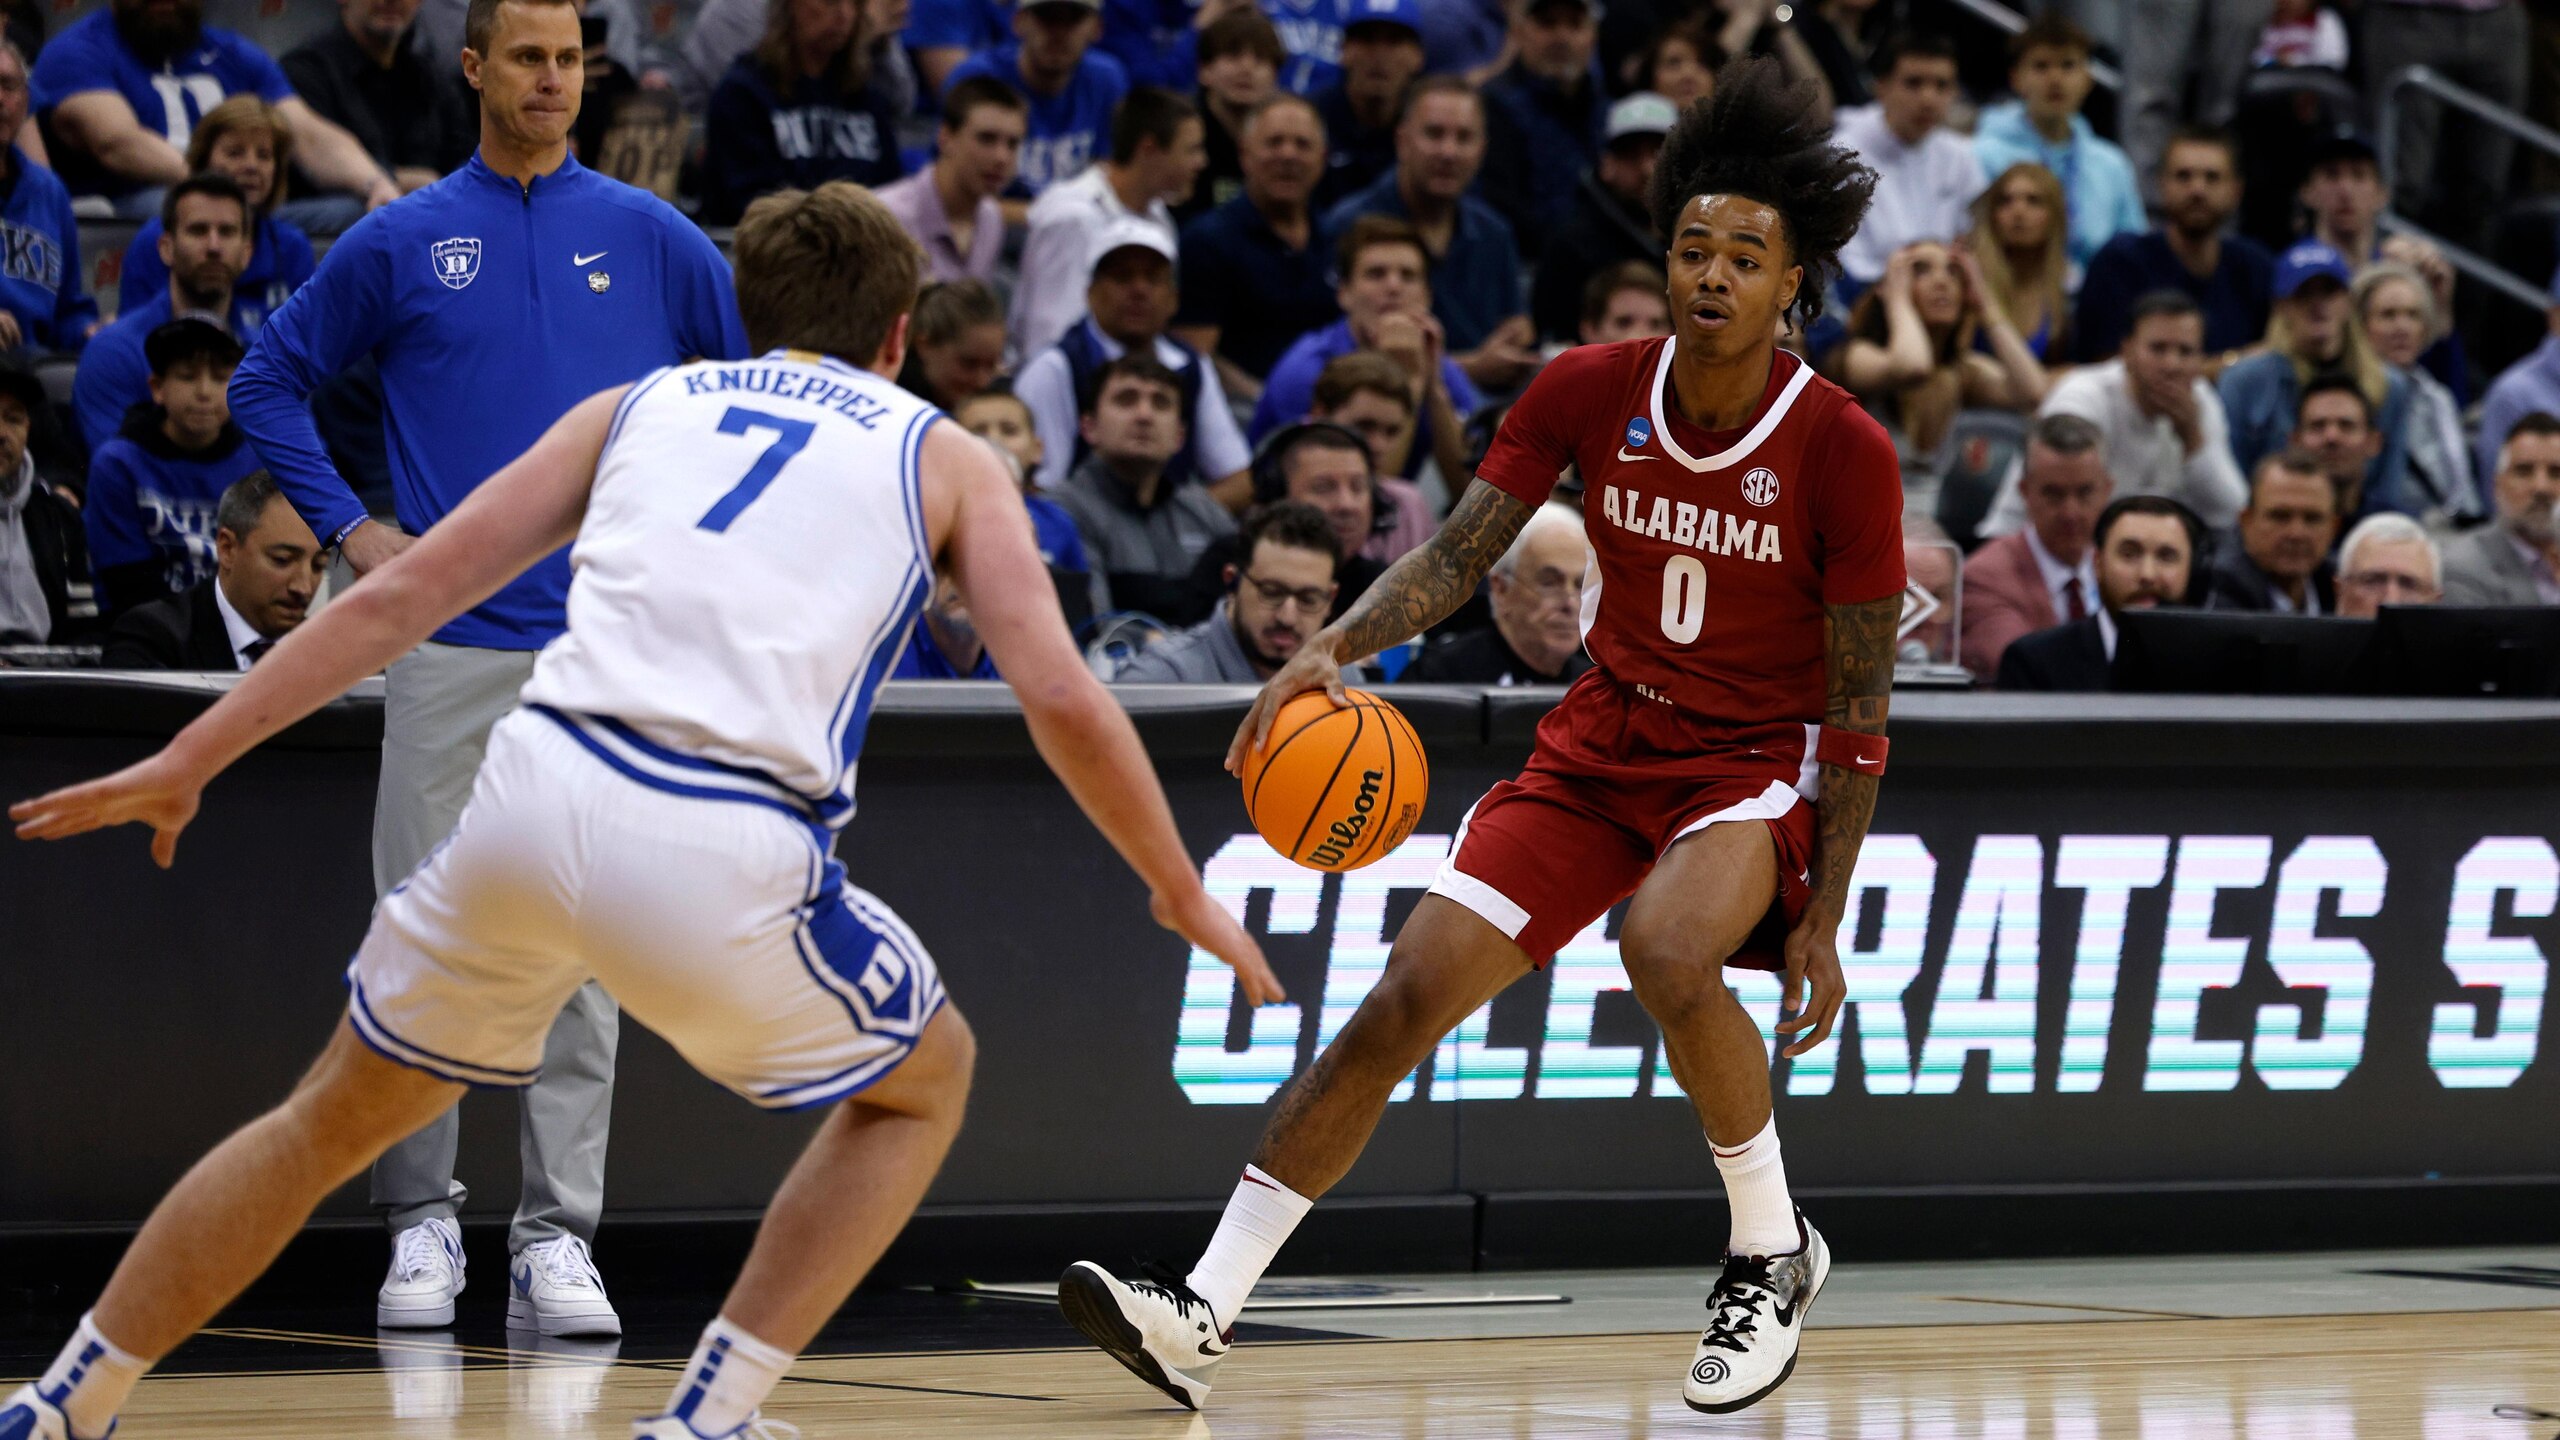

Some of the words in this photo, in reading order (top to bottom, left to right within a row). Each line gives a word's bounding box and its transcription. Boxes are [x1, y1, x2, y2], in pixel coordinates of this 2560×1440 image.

[0, 220, 61, 296] KE
[684, 368, 890, 431] KNUEPPEL
[1628, 428, 1648, 442] NCAA
[696, 406, 816, 534] 7
[1744, 470, 1776, 504] SEC
[1603, 484, 1783, 563] ALABAMA
[1660, 554, 1707, 645] 0
[1306, 768, 1384, 868] Wilson
[858, 939, 907, 1008] D
[1172, 833, 2389, 1105] CEERATES
[2427, 835, 2560, 1089] S
